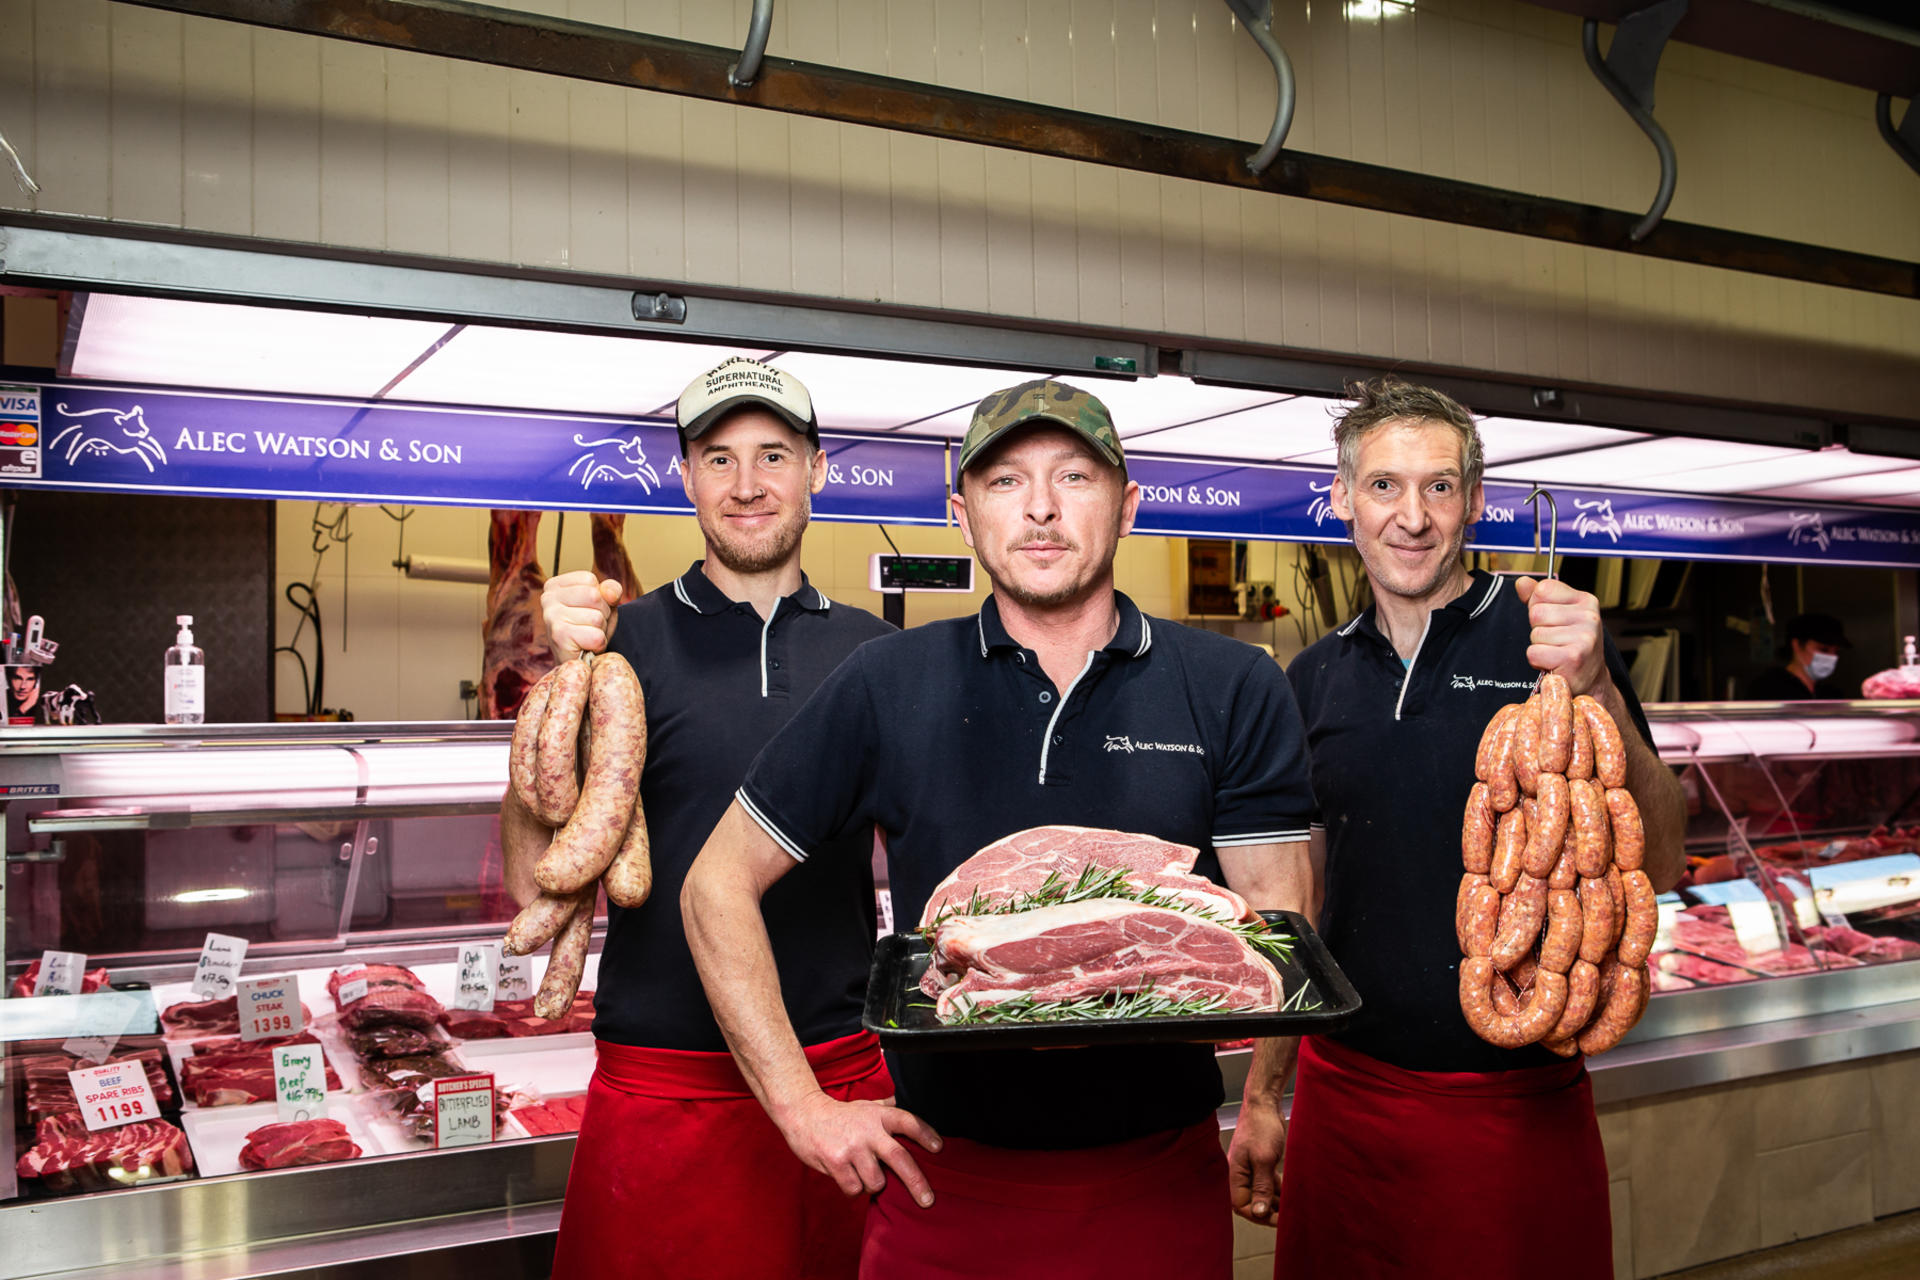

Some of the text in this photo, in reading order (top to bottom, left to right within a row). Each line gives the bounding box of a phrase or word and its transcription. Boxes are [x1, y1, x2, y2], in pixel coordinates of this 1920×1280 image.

[705, 371, 784, 388] SUPERNATURAL
[707, 380, 784, 396] AMPHITHEATRE
[0, 397, 37, 411] VISA
[379, 438, 402, 461] &
[827, 463, 846, 484] &
[1187, 486, 1202, 504] &
[251, 990, 284, 1001] CHUCK
[255, 1002, 284, 1013] STEAK
[99, 1076, 122, 1087] BEEF
[85, 1085, 144, 1103] SPARE RIBS
[448, 1115, 480, 1131] LAMB
